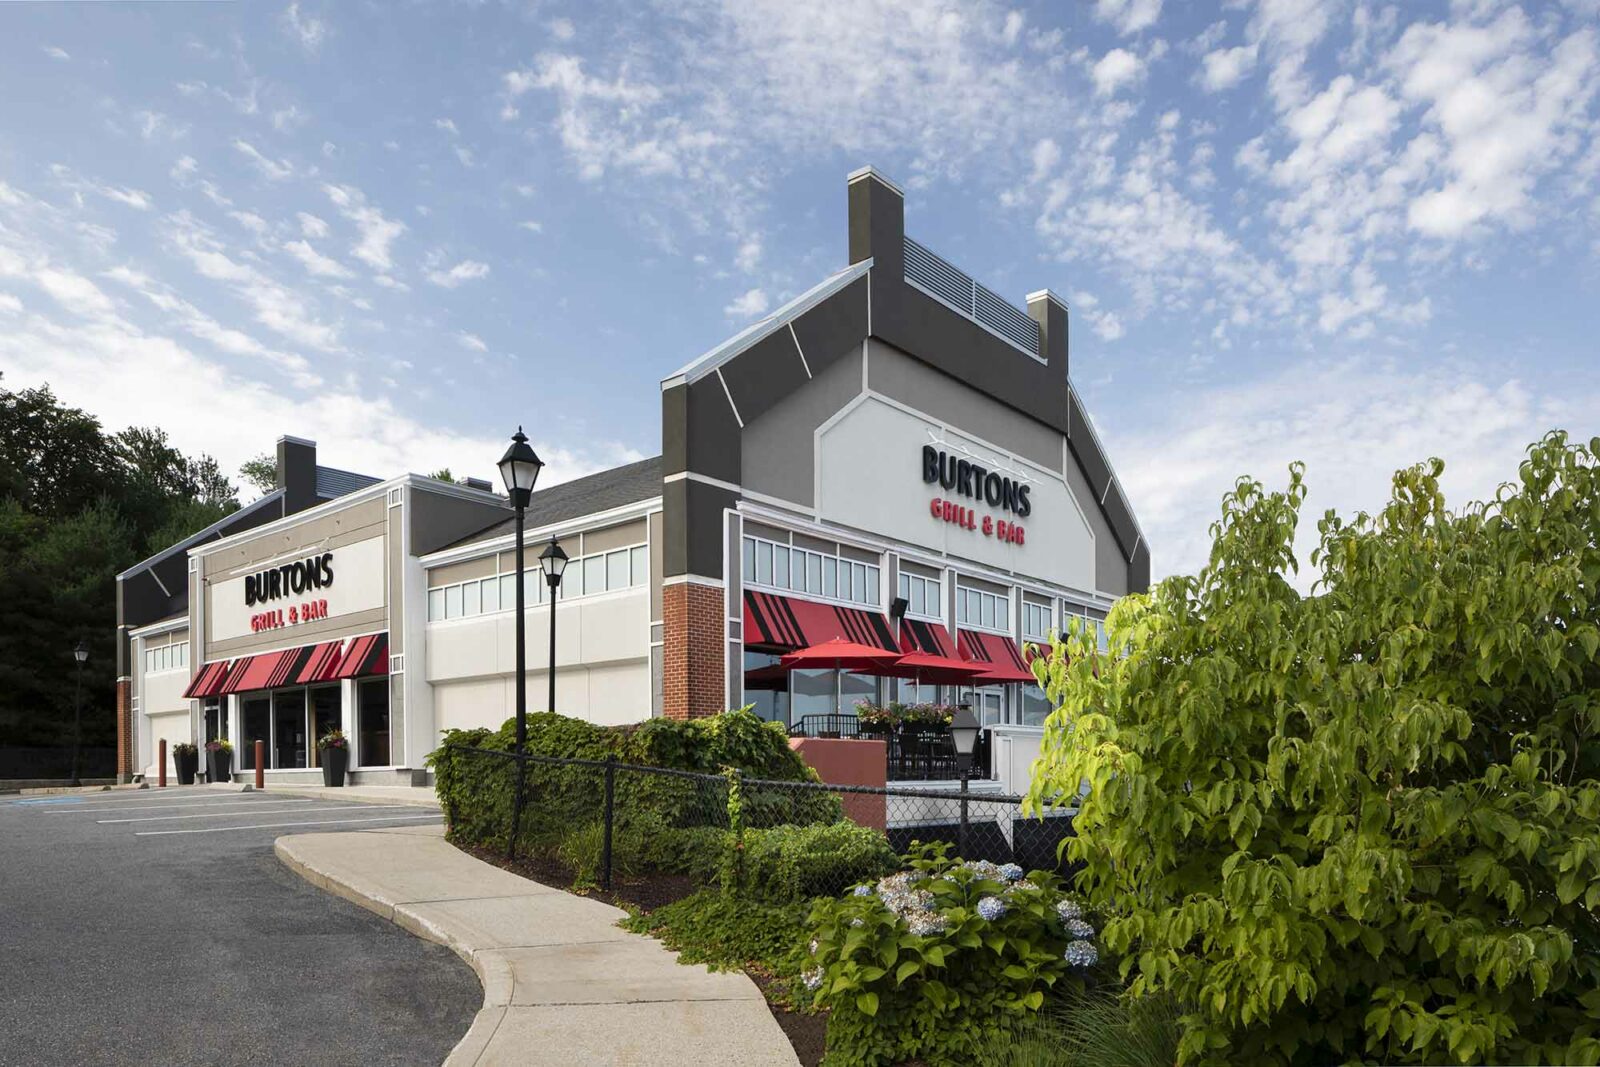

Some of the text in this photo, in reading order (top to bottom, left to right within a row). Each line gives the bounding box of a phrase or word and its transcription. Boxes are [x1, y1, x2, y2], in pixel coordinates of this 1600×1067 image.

[923, 445, 1031, 517] BURTONS
[930, 498, 1025, 545] GRILL & BAR
[245, 553, 334, 607] BURTONS
[251, 599, 328, 632] GRILL & BAR
